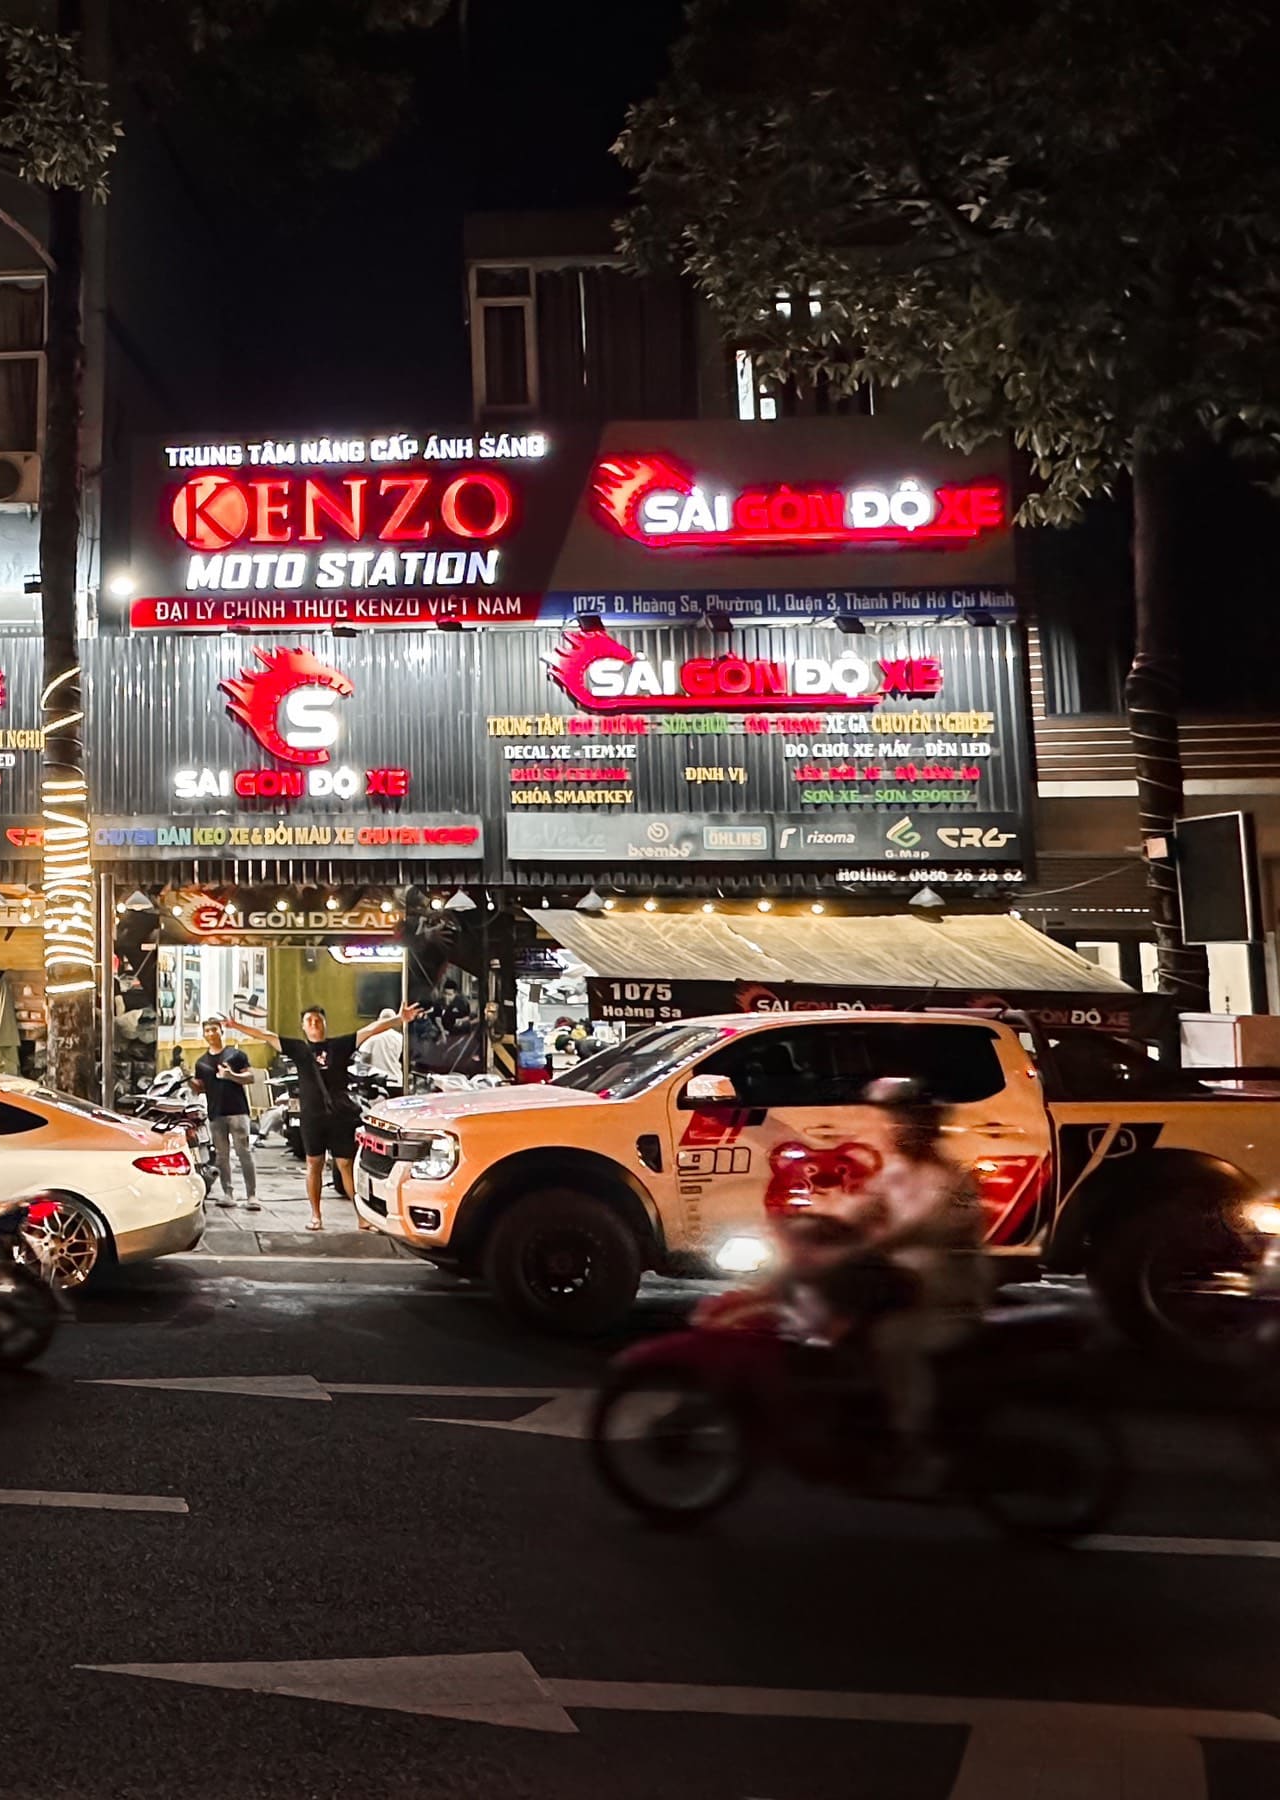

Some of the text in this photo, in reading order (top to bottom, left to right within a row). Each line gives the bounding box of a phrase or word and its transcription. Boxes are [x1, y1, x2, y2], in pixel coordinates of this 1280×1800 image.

[165, 431, 546, 468] TRUNG TÂM NÂNG CẤP ÁNH SÁNG
[172, 474, 512, 549] KENZO
[643, 480, 1004, 533] SÀI GÒN ĐỘ XE
[186, 549, 500, 590] MOTO STATION
[155, 601, 187, 622] ĐẠI
[196, 600, 215, 620] LÝ
[223, 597, 283, 620] CHÍNH
[355, 598, 419, 617] KENZO
[477, 597, 521, 615] NAM
[633, 595, 676, 616] Hoàng
[844, 593, 888, 610] Thành
[980, 590, 1015, 607] Minh
[591, 652, 675, 696] SÀI
[879, 657, 943, 695] XE
[488, 716, 532, 735] TRUNG
[536, 713, 565, 735] TÂM
[826, 714, 845, 733] XE
[848, 714, 869, 733] GA
[504, 745, 637, 759] DECAL XE TEM XE
[853, 743, 874, 757] XE
[879, 739, 911, 757] MÁY
[961, 743, 990, 757] LED
[173, 767, 232, 798] SÀI
[365, 769, 409, 798] XE
[511, 786, 633, 804] KHÓA SMARTKEY
[193, 828, 226, 846] KEO
[229, 828, 250, 846] XE
[335, 828, 355, 846] XE
[807, 830, 855, 844] rizoma
[609, 983, 672, 1001] 1075
[602, 1004, 682, 1020] Hoàng Sa
